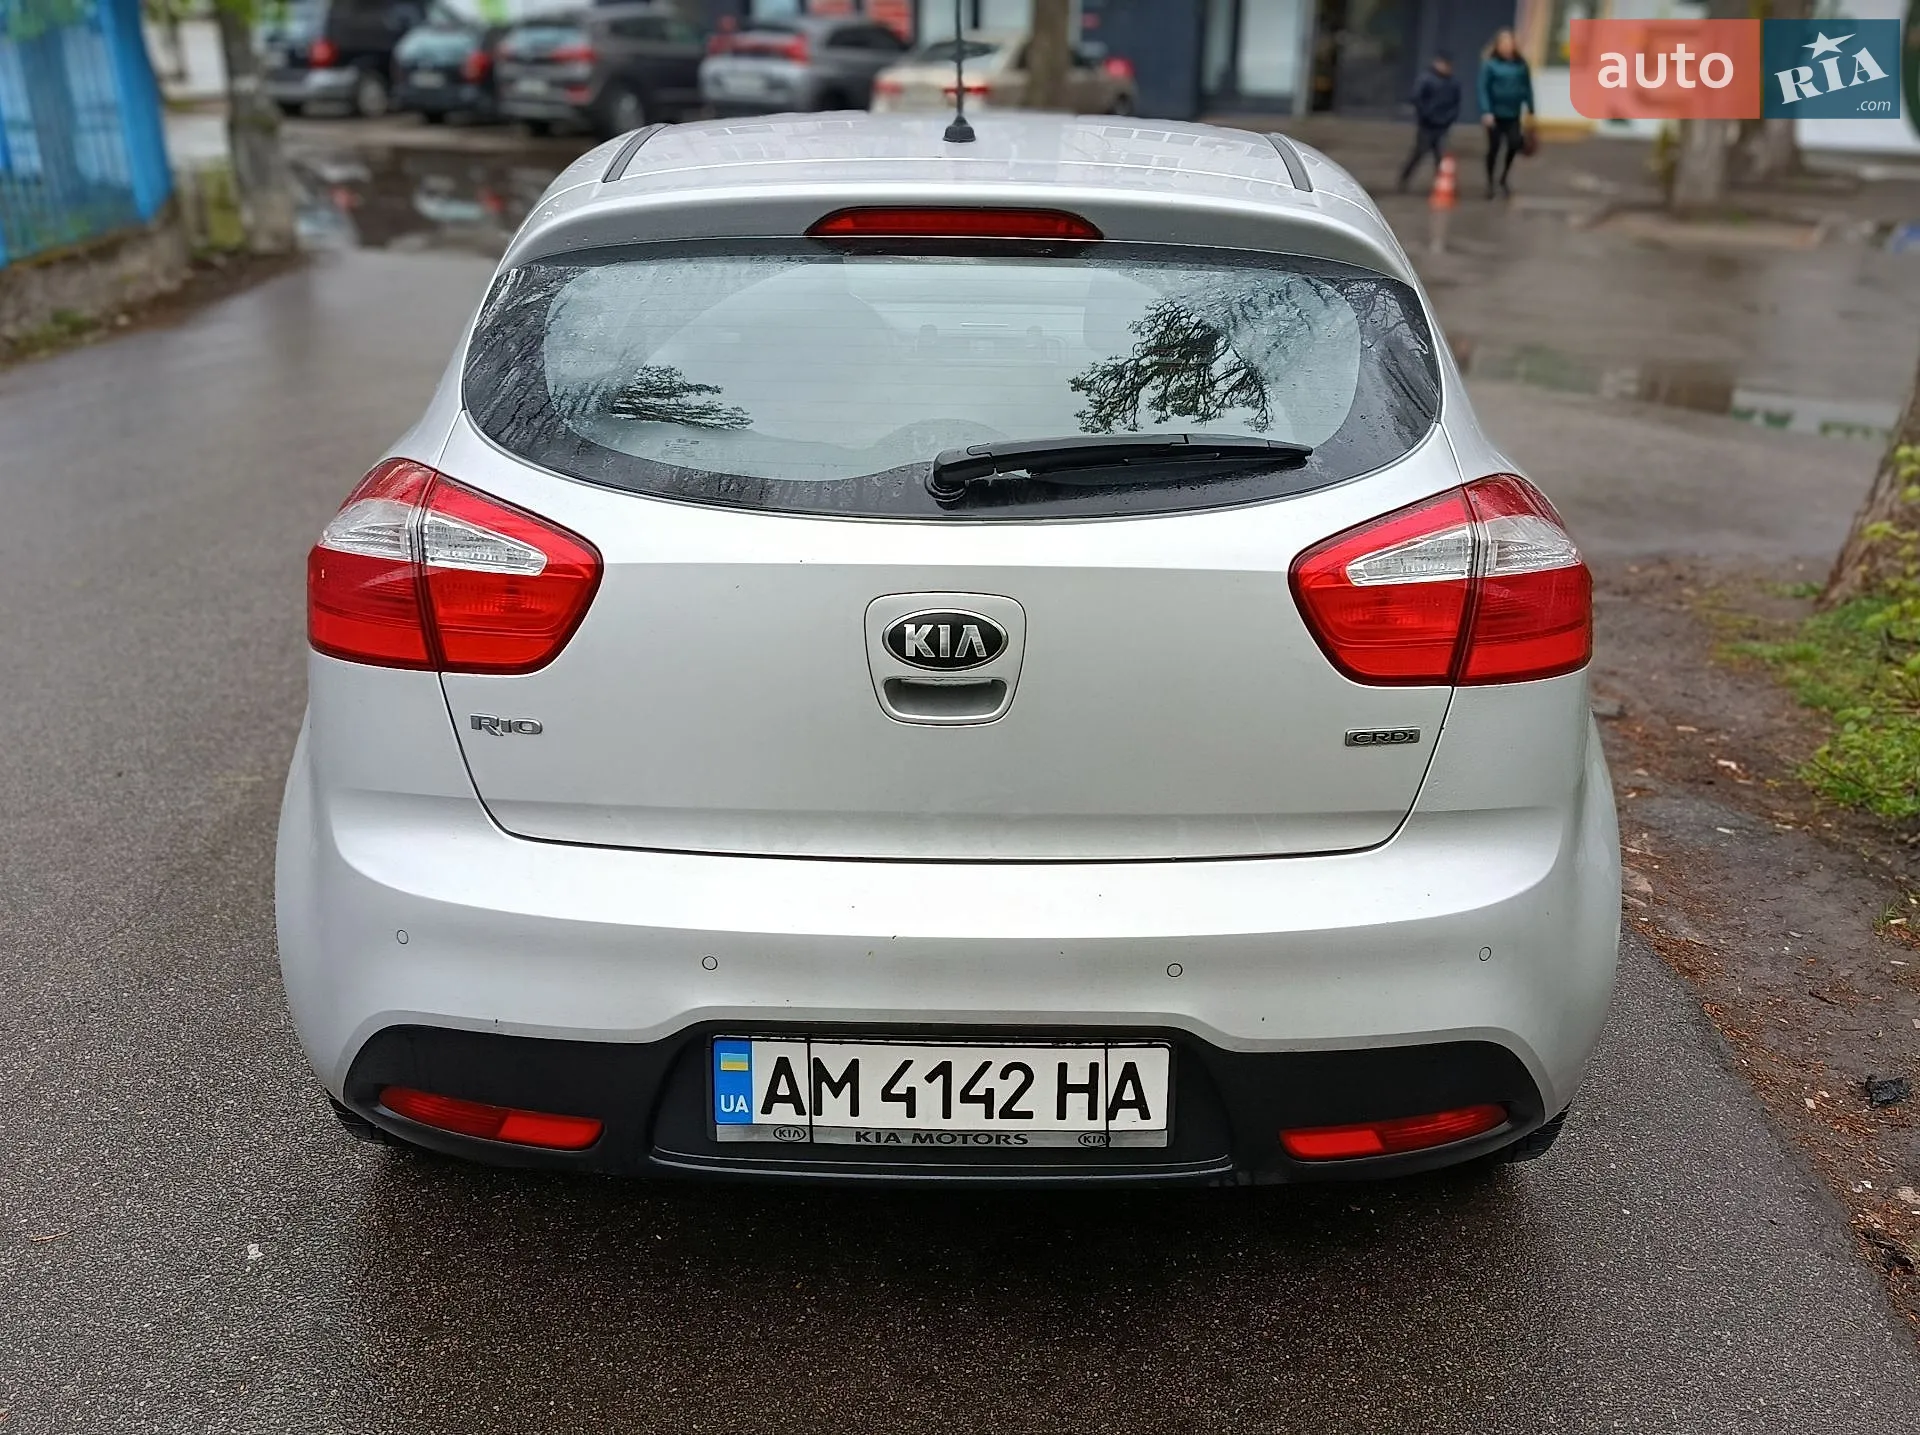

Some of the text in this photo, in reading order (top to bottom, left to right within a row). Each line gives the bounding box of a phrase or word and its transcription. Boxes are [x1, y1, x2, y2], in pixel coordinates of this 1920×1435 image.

[904, 624, 987, 658] KIA
[470, 713, 543, 736] RIO
[1352, 731, 1415, 744] CRDi
[760, 1056, 1152, 1121] AM 4142 HA
[720, 1095, 749, 1113] UA
[854, 1131, 1029, 1146] KIA MOTORS
